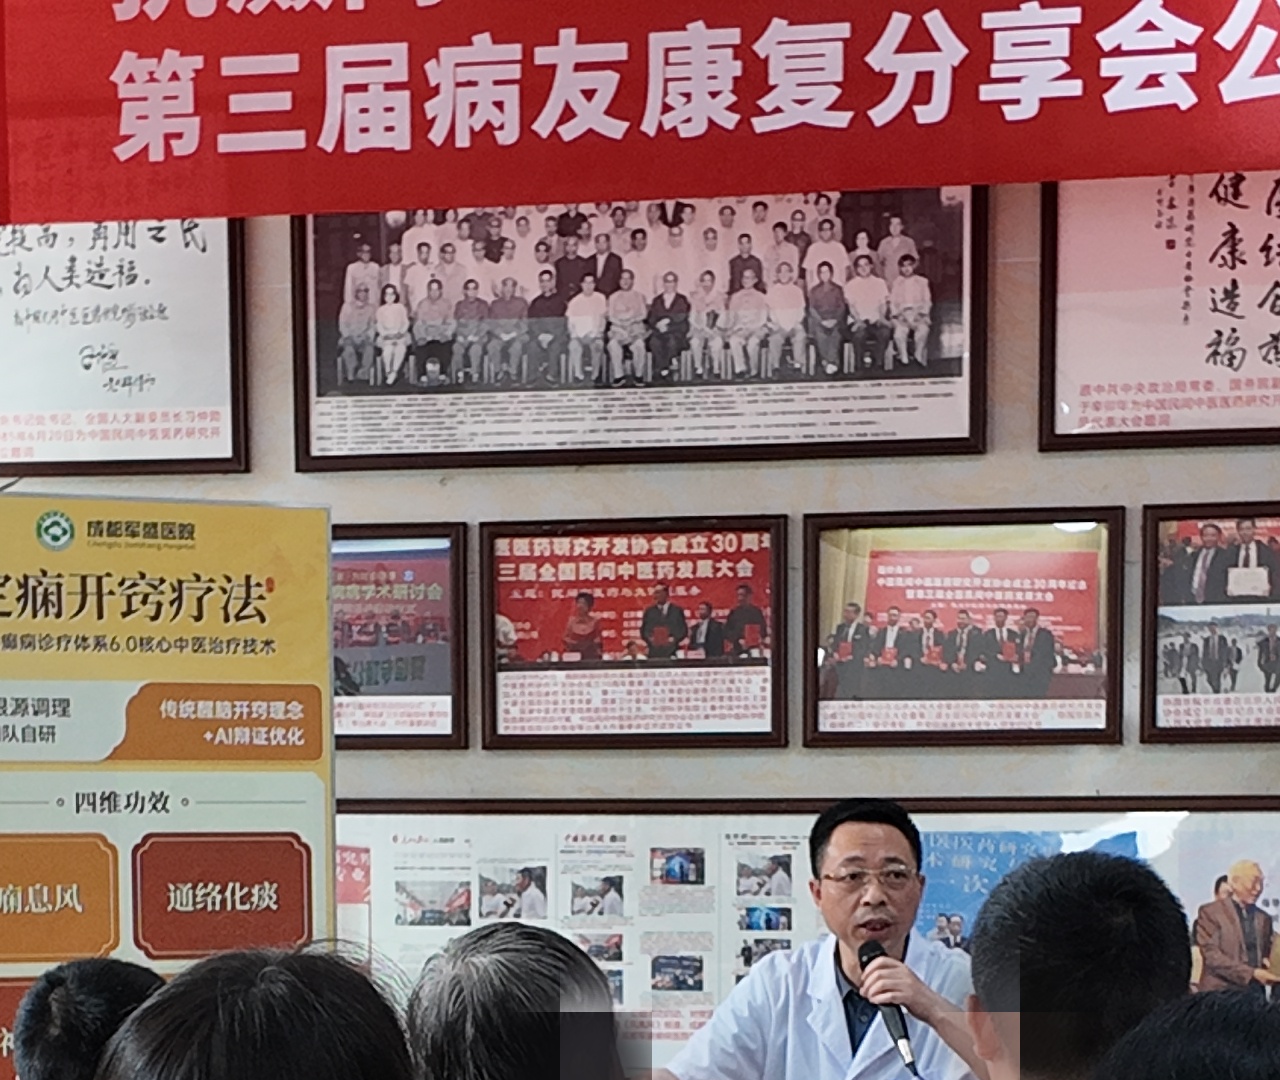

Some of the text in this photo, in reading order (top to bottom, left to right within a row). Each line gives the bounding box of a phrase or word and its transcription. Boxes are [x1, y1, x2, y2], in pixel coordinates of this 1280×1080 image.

[74, 791, 171, 814] 四维功效
[167, 882, 278, 913] 通络化痰
